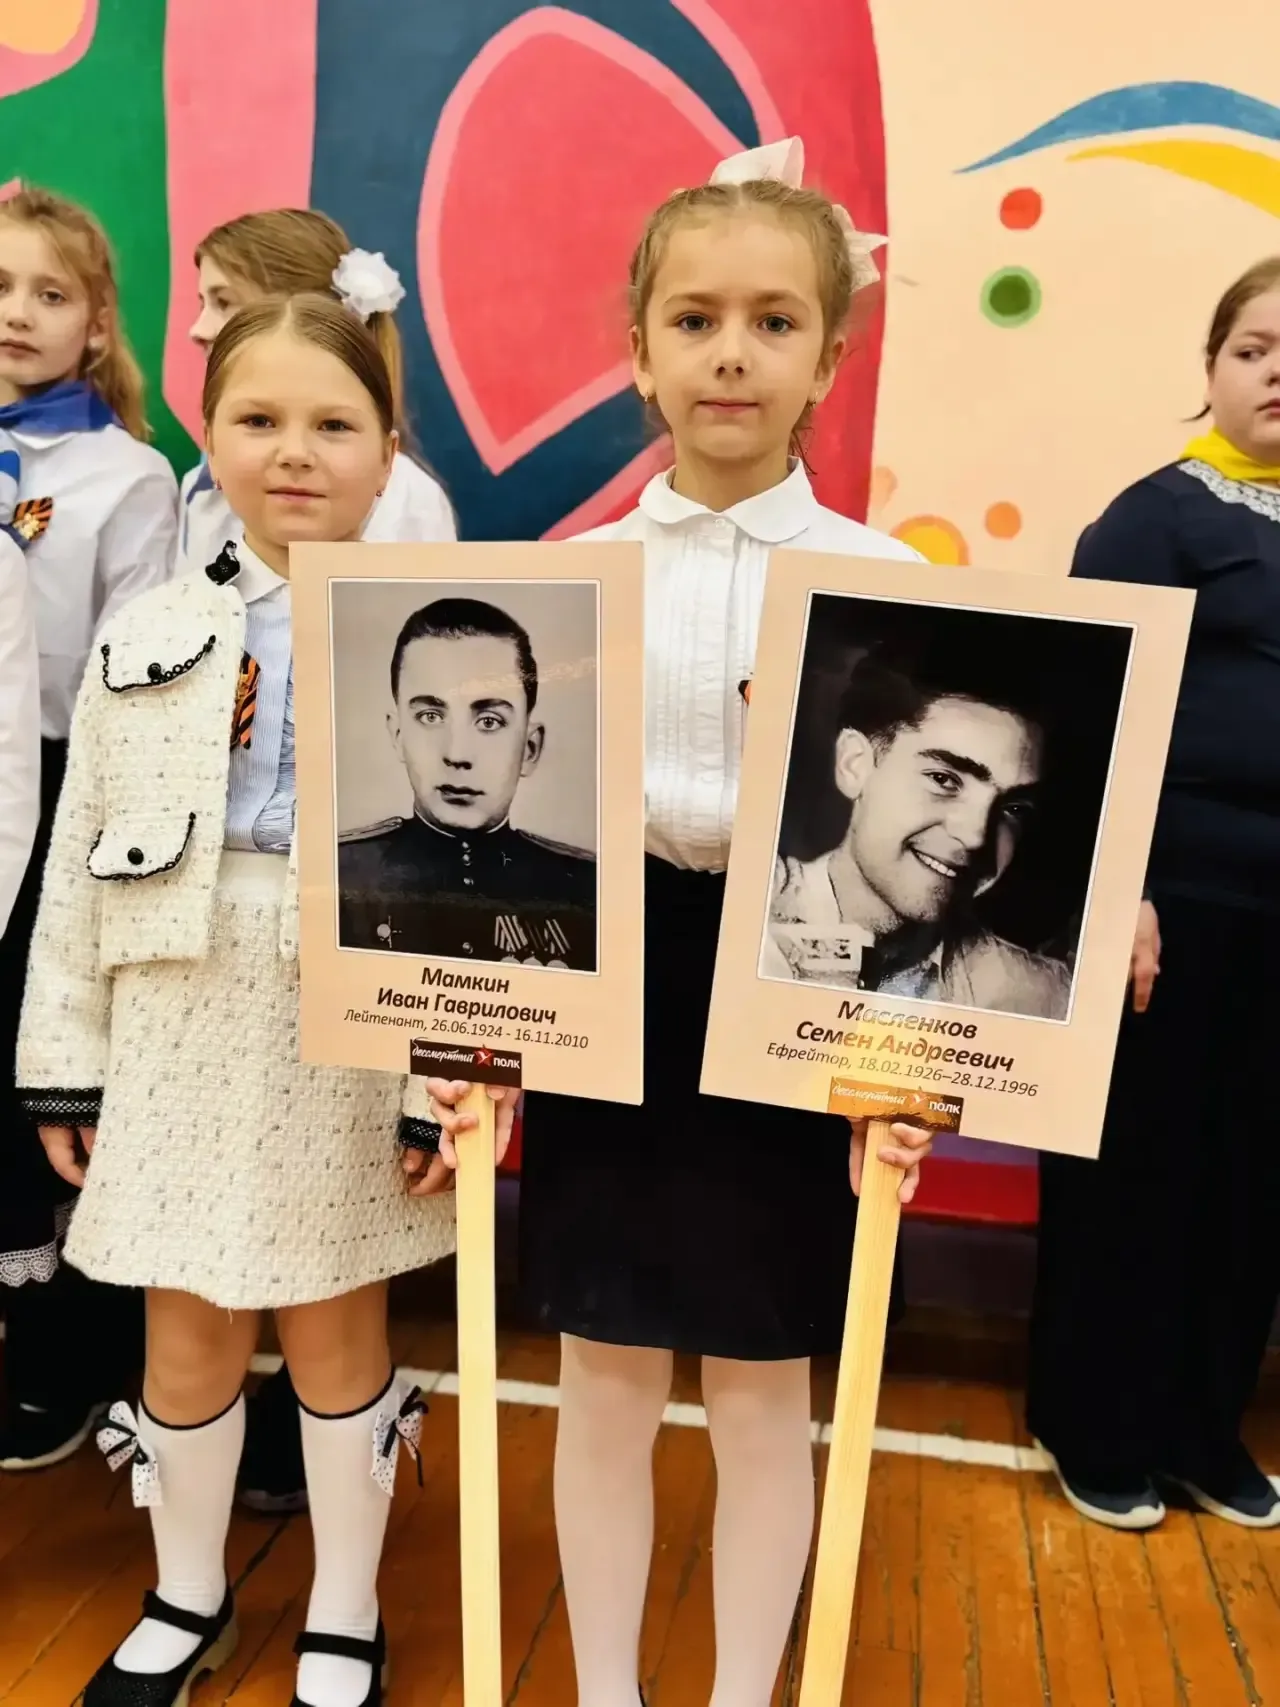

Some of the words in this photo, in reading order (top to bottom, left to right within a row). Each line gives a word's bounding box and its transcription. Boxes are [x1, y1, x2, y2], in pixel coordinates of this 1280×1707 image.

[421, 967, 510, 993] Мамкин
[377, 988, 429, 1011] Иван
[434, 993, 557, 1025] Гаврилович
[837, 1000, 978, 1039] Масленков
[344, 1009, 428, 1032] Лейтенант,
[431, 1018, 503, 1038] 26.06.1924
[514, 1028, 589, 1049] 16.11.2010
[796, 1021, 874, 1050] Семен
[877, 1035, 1015, 1072] Андреевич
[767, 1042, 852, 1070] Ефрейтор,
